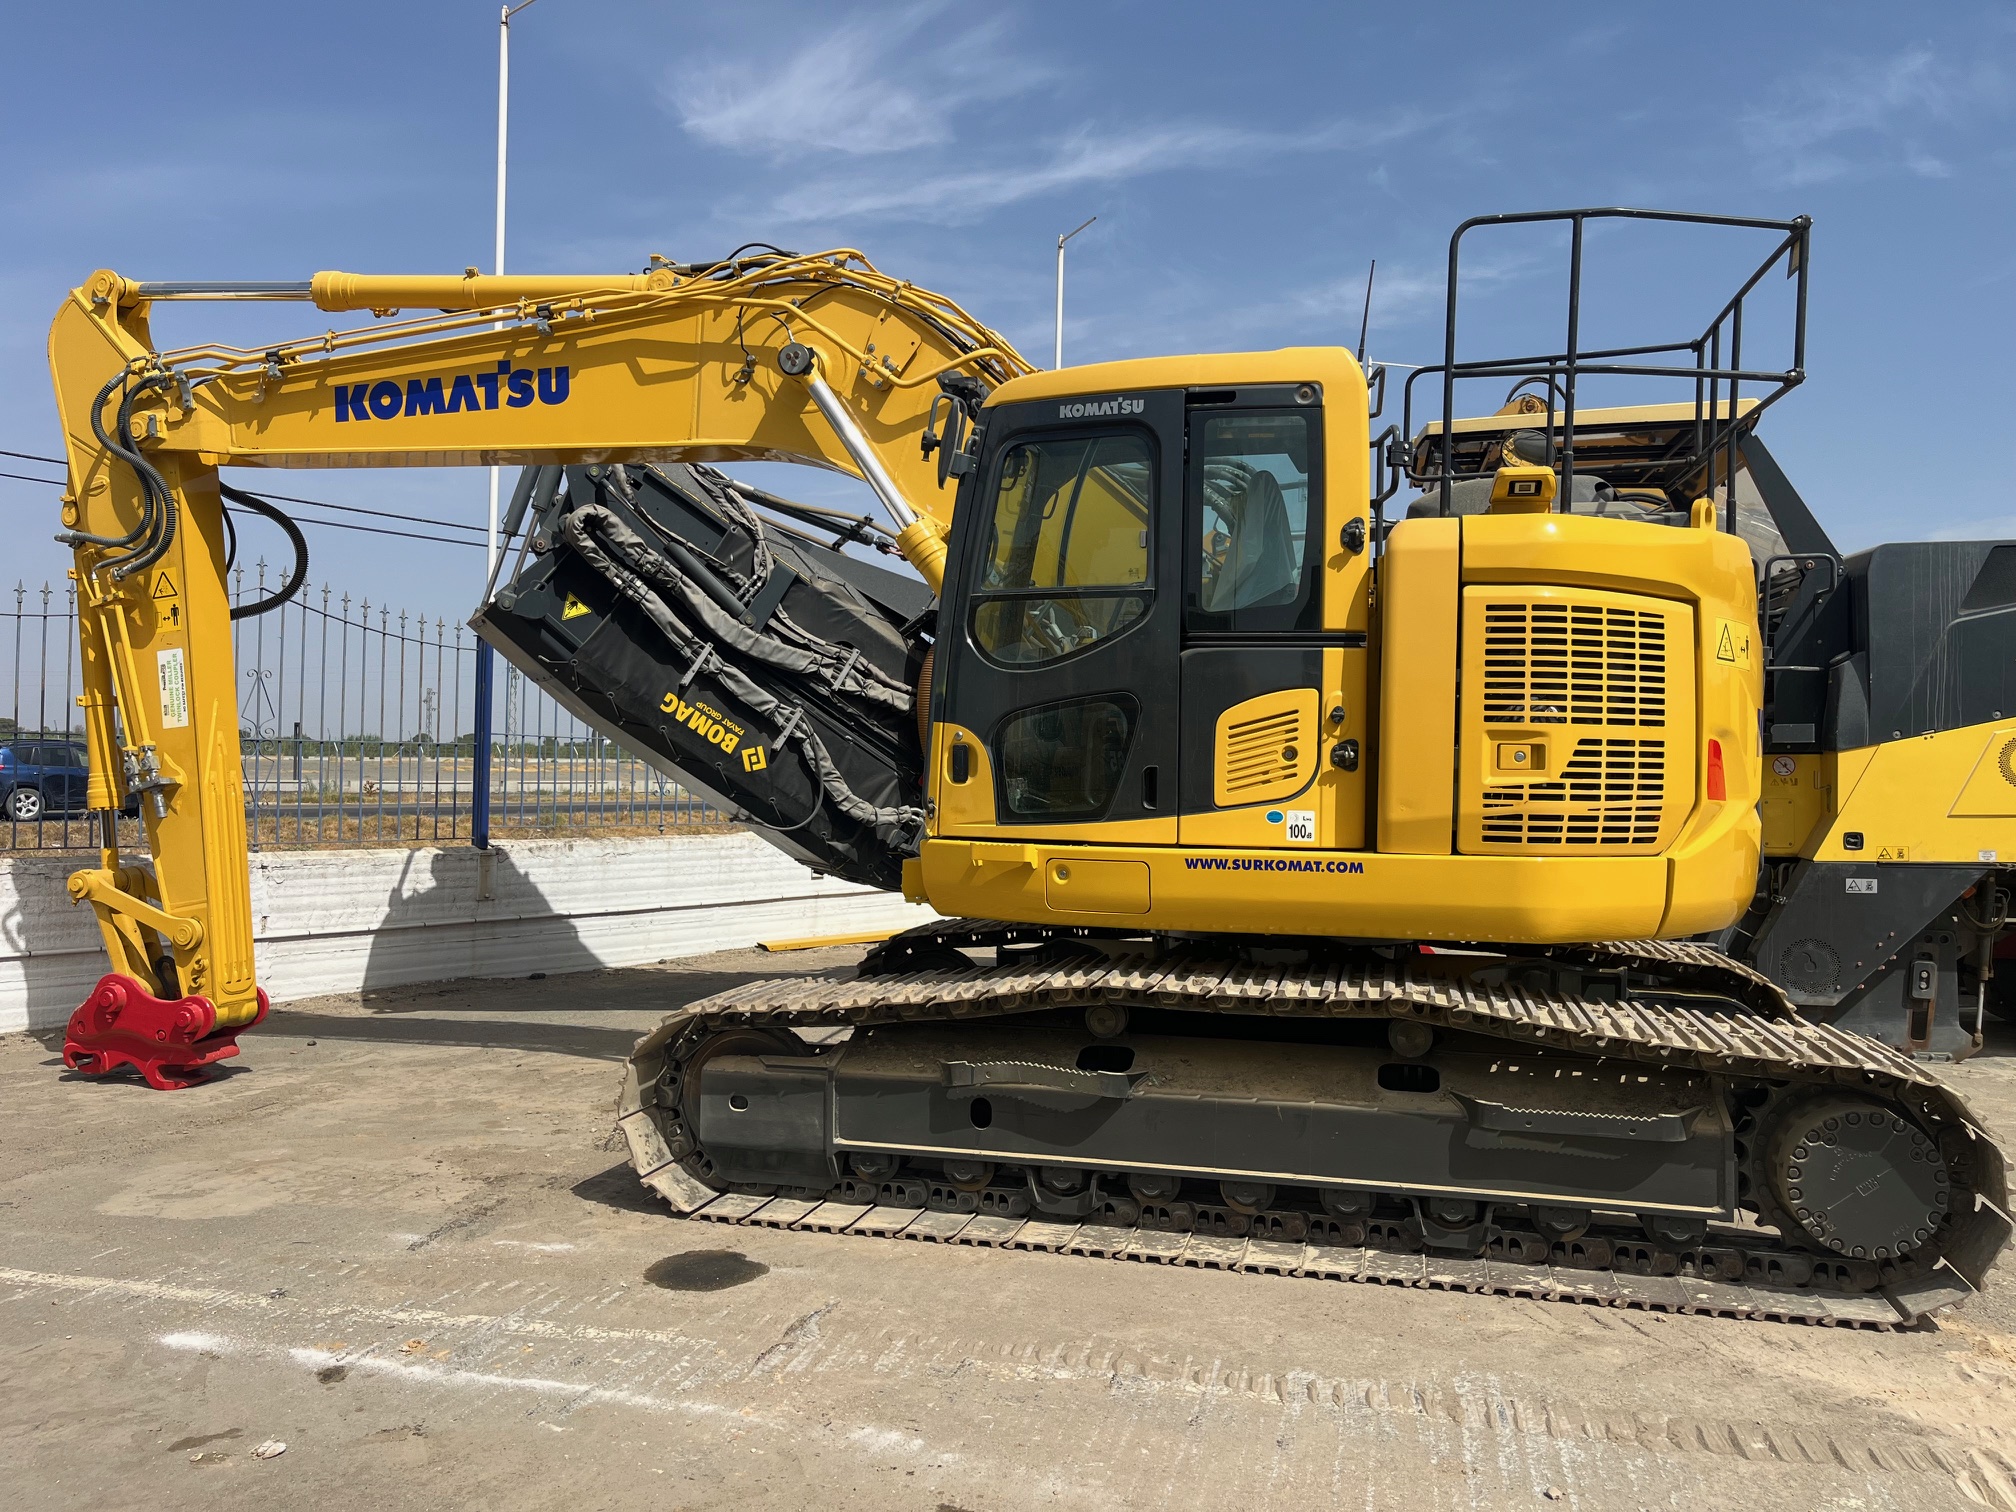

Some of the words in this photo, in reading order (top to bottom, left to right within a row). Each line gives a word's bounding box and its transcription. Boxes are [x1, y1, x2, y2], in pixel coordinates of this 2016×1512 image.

[334, 360, 569, 422] KOMATSU
[1059, 396, 1145, 418] KOMATSU
[175, 686, 183, 723] TWINLOCK
[696, 701, 723, 720] GROUP
[660, 692, 739, 754] BOMAG
[721, 718, 745, 736] FAYAT
[1289, 824, 1307, 839] 100
[1185, 858, 1364, 873] WWW.SURKOMAT.COM
